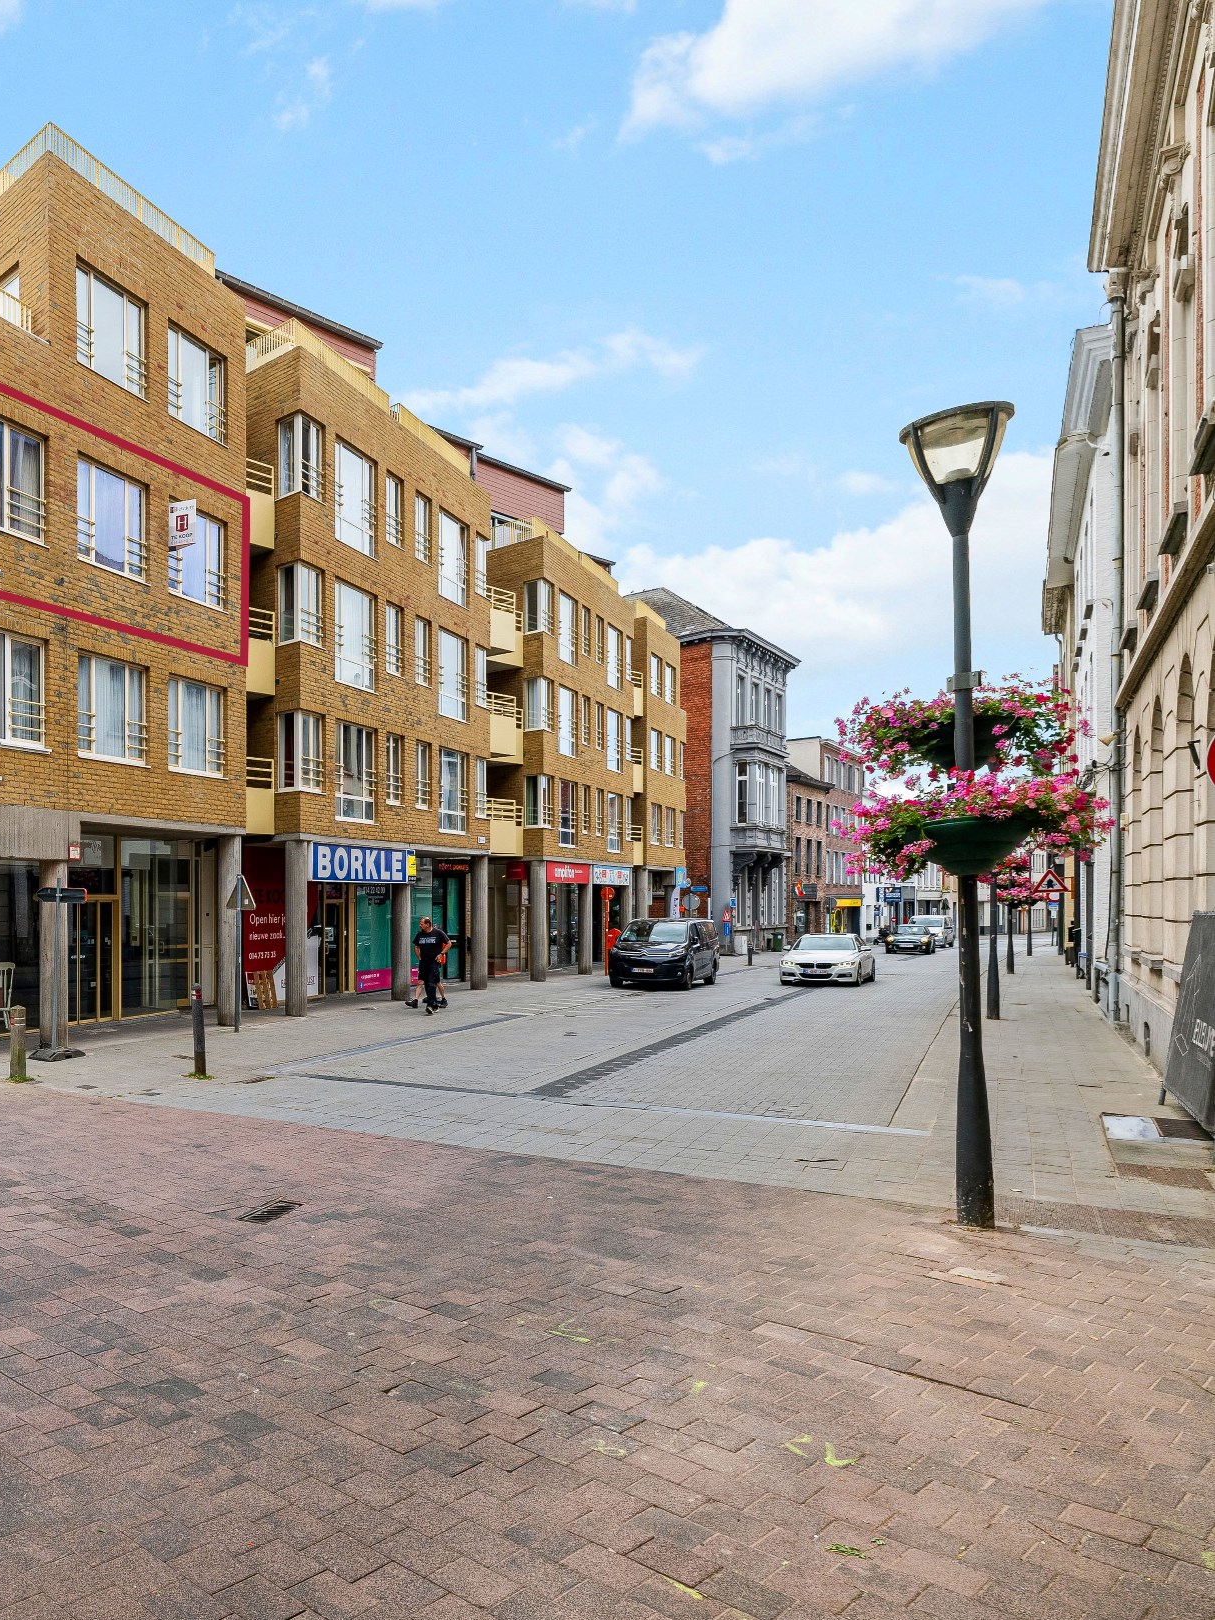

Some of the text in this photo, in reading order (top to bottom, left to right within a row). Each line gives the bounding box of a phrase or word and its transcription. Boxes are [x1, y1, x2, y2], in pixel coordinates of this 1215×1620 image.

[318, 846, 402, 880] BORKLE
[253, 887, 285, 904] TE KOO
[249, 913, 268, 927] Open
[268, 913, 281, 924] hier
[249, 931, 268, 940] nieuwe
[248, 951, 258, 960] 014
